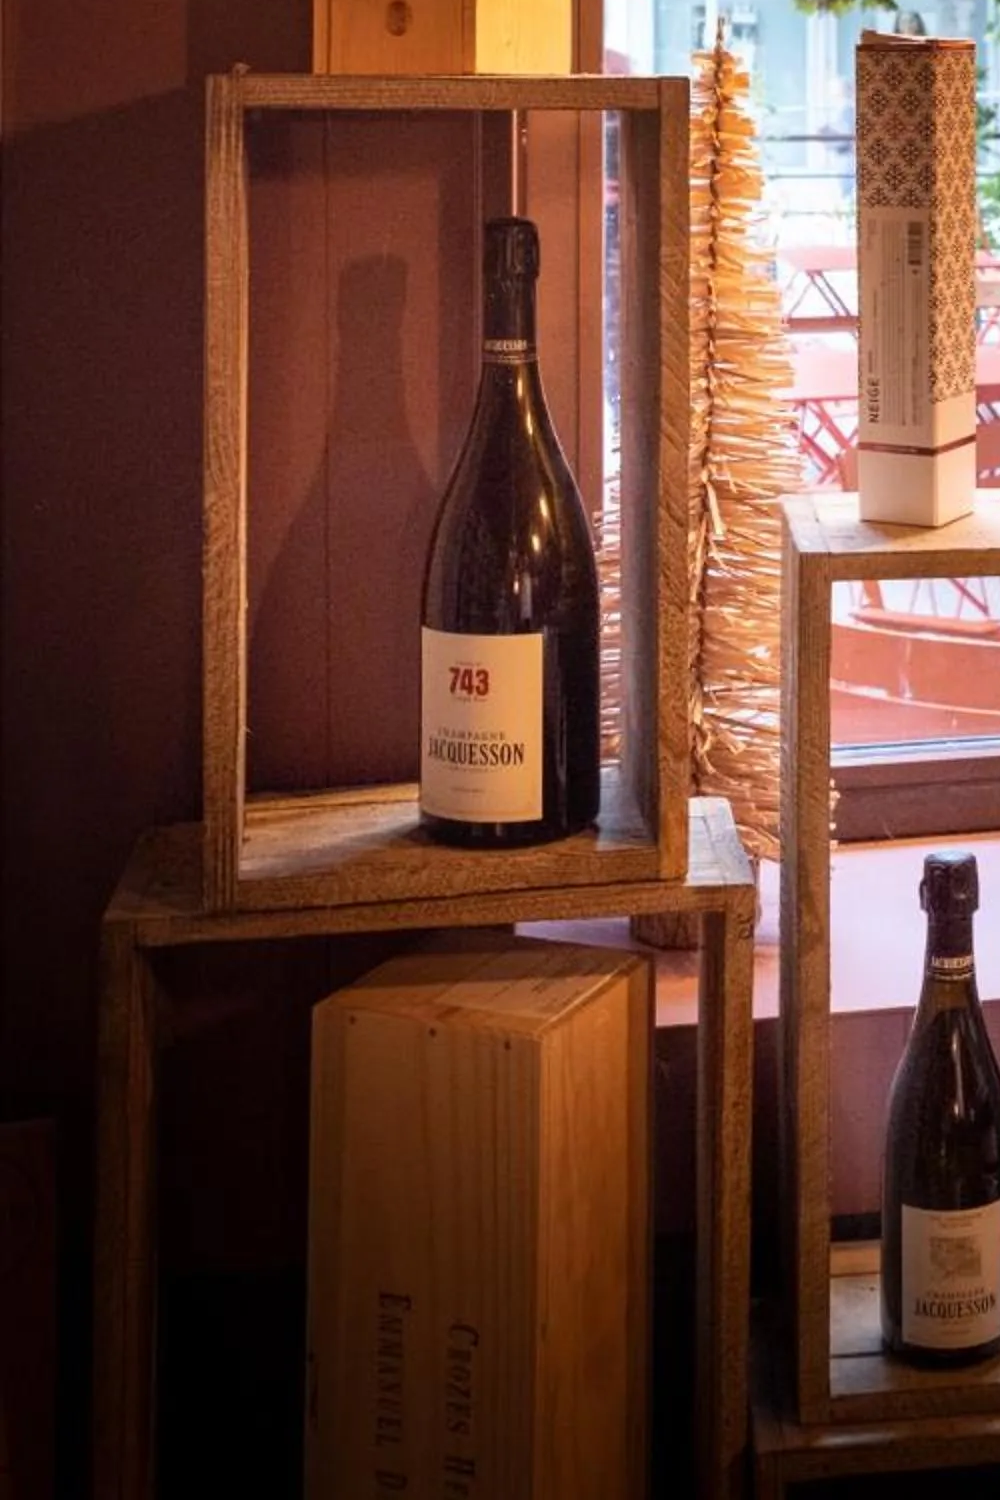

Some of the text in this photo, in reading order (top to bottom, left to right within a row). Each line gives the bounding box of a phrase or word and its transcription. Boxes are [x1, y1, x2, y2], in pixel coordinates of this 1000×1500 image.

[868, 377, 880, 424] NEIGE
[448, 666, 490, 696] 743
[428, 736, 526, 767] JACQUESSON
[914, 1293, 996, 1319] JACQUESSON
[375, 1290, 412, 1448] EMMANUEL
